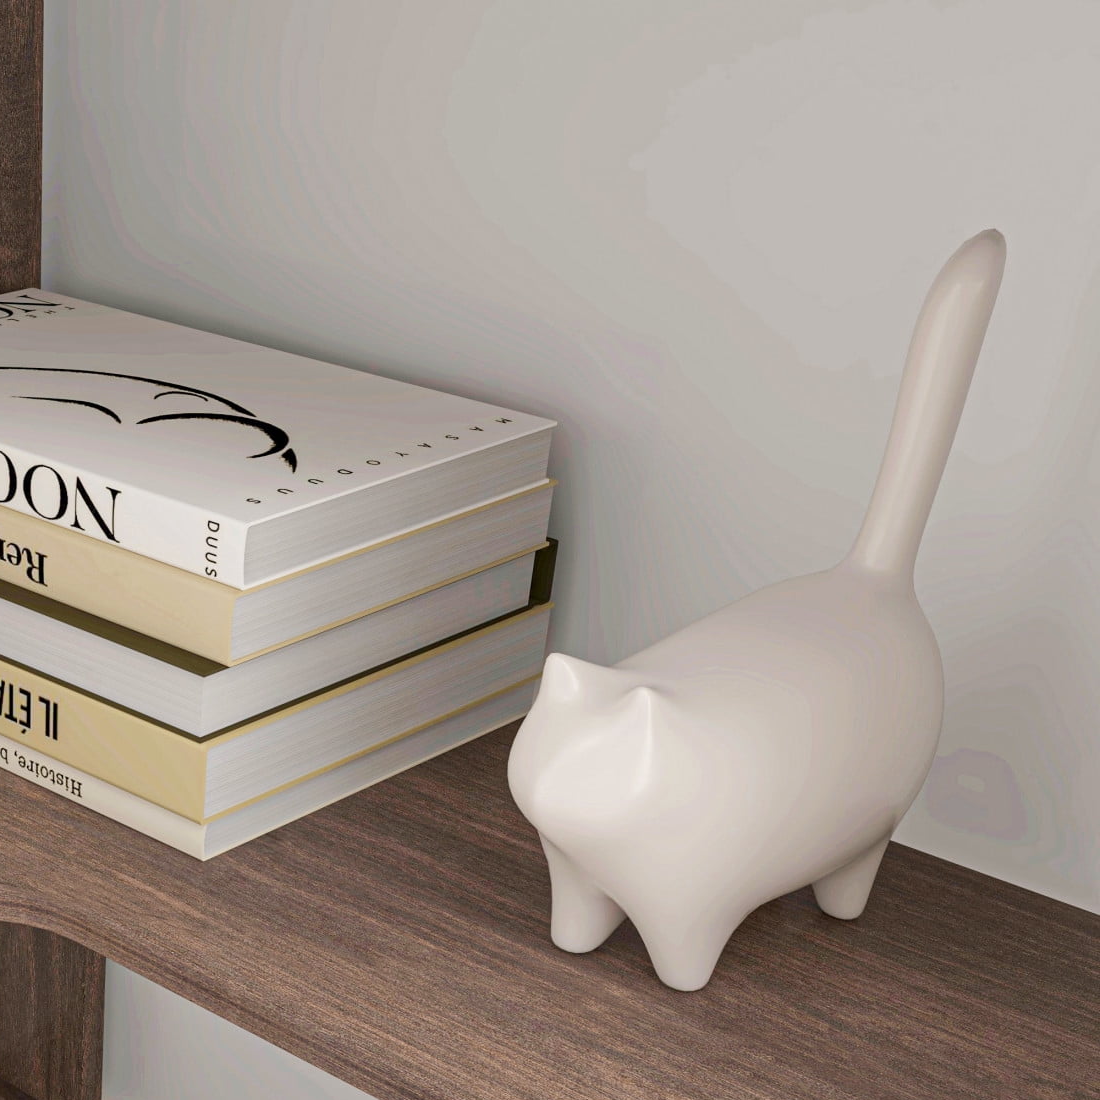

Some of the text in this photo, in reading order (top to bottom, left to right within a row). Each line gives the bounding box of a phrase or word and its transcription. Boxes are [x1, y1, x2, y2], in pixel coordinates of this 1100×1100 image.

[204, 520, 220, 578] DUUS
[39, 698, 59, 740] IL
[15, 751, 83, 799] Histoire,
